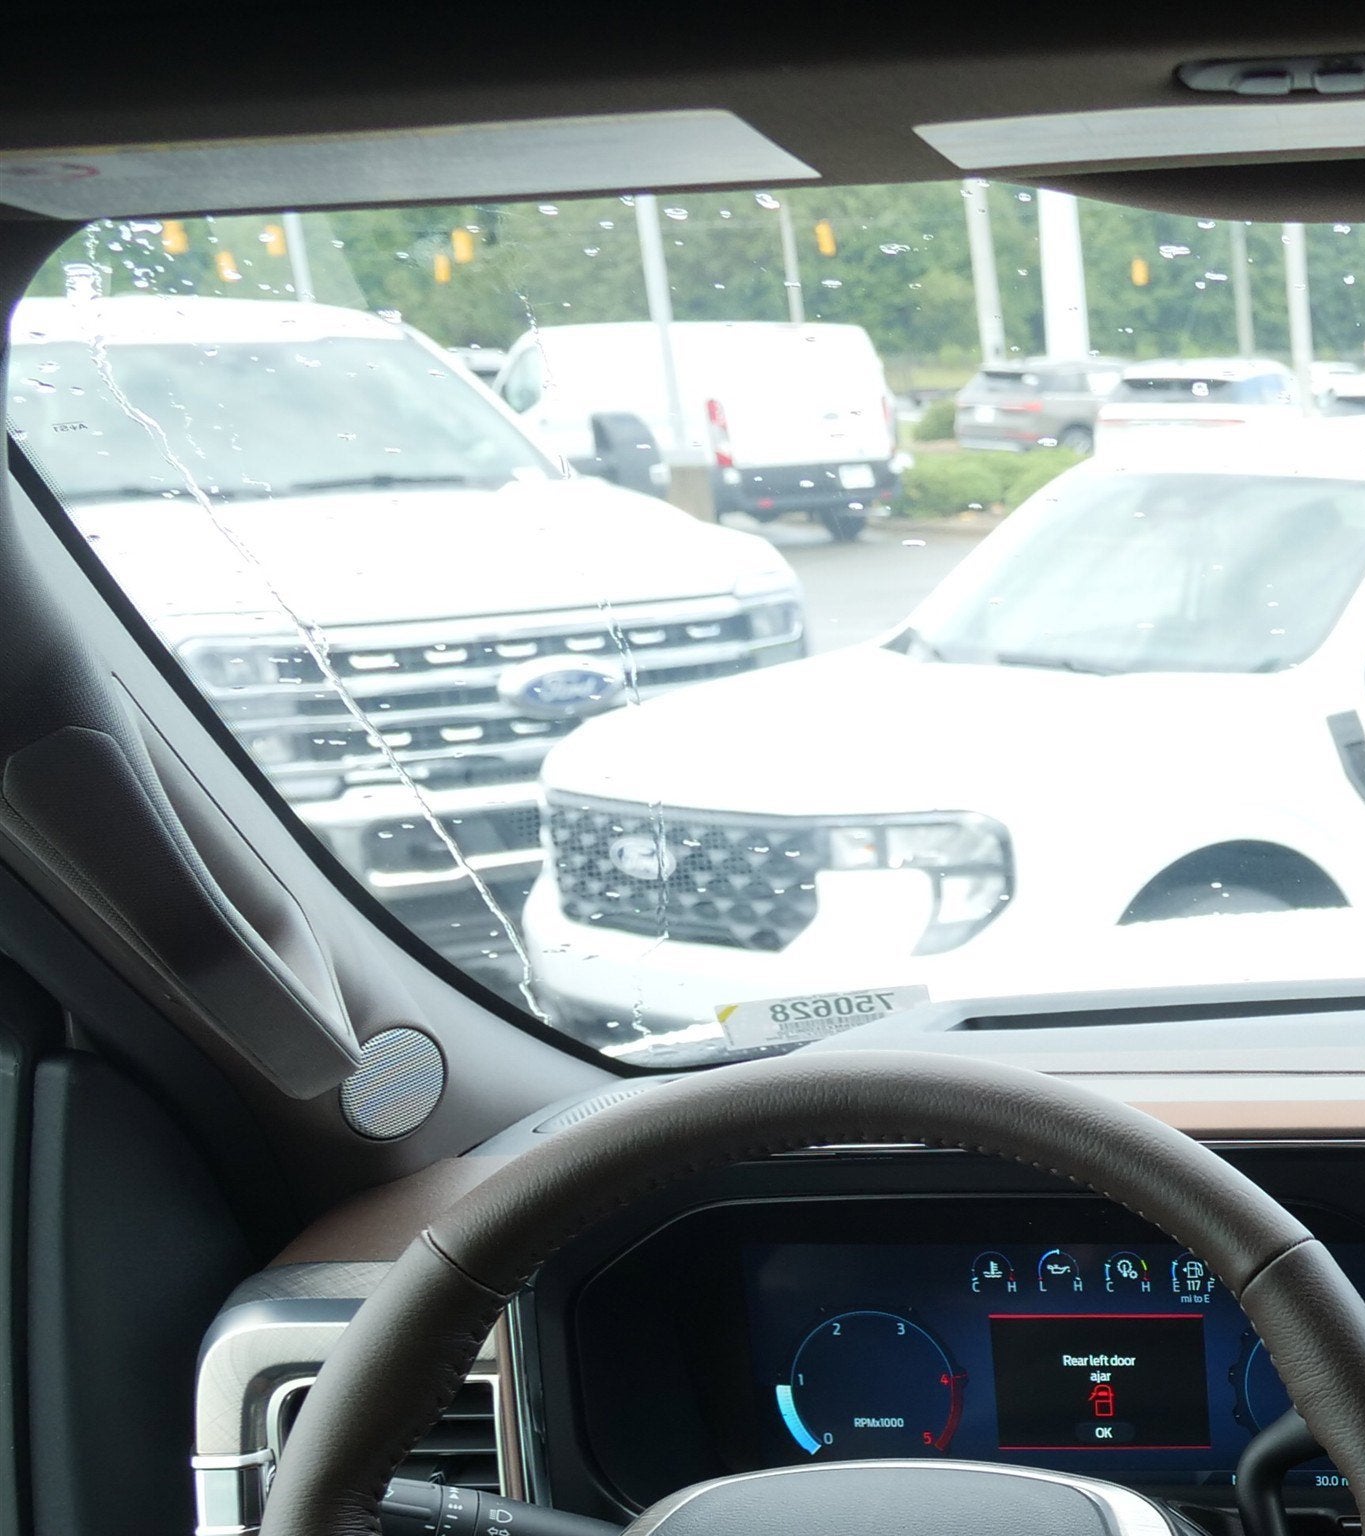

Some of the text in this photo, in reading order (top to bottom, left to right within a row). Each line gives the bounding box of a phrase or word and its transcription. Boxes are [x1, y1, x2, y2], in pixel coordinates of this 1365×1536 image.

[1186, 1280, 1200, 1292] 117
[1180, 1294, 1192, 1304] mi
[1193, 1294, 1202, 1304] to
[832, 1322, 842, 1336] 2
[896, 1322, 906, 1336] 3
[1062, 1354, 1136, 1366] Rear left door
[940, 1374, 949, 1386] 4
[1090, 1371, 1112, 1383] ajar
[854, 1417, 904, 1428] RPMx1000
[823, 1432, 834, 1445] 0
[923, 1432, 932, 1444] 5
[1095, 1427, 1113, 1439] OK
[1315, 1475, 1338, 1487] 30.0
